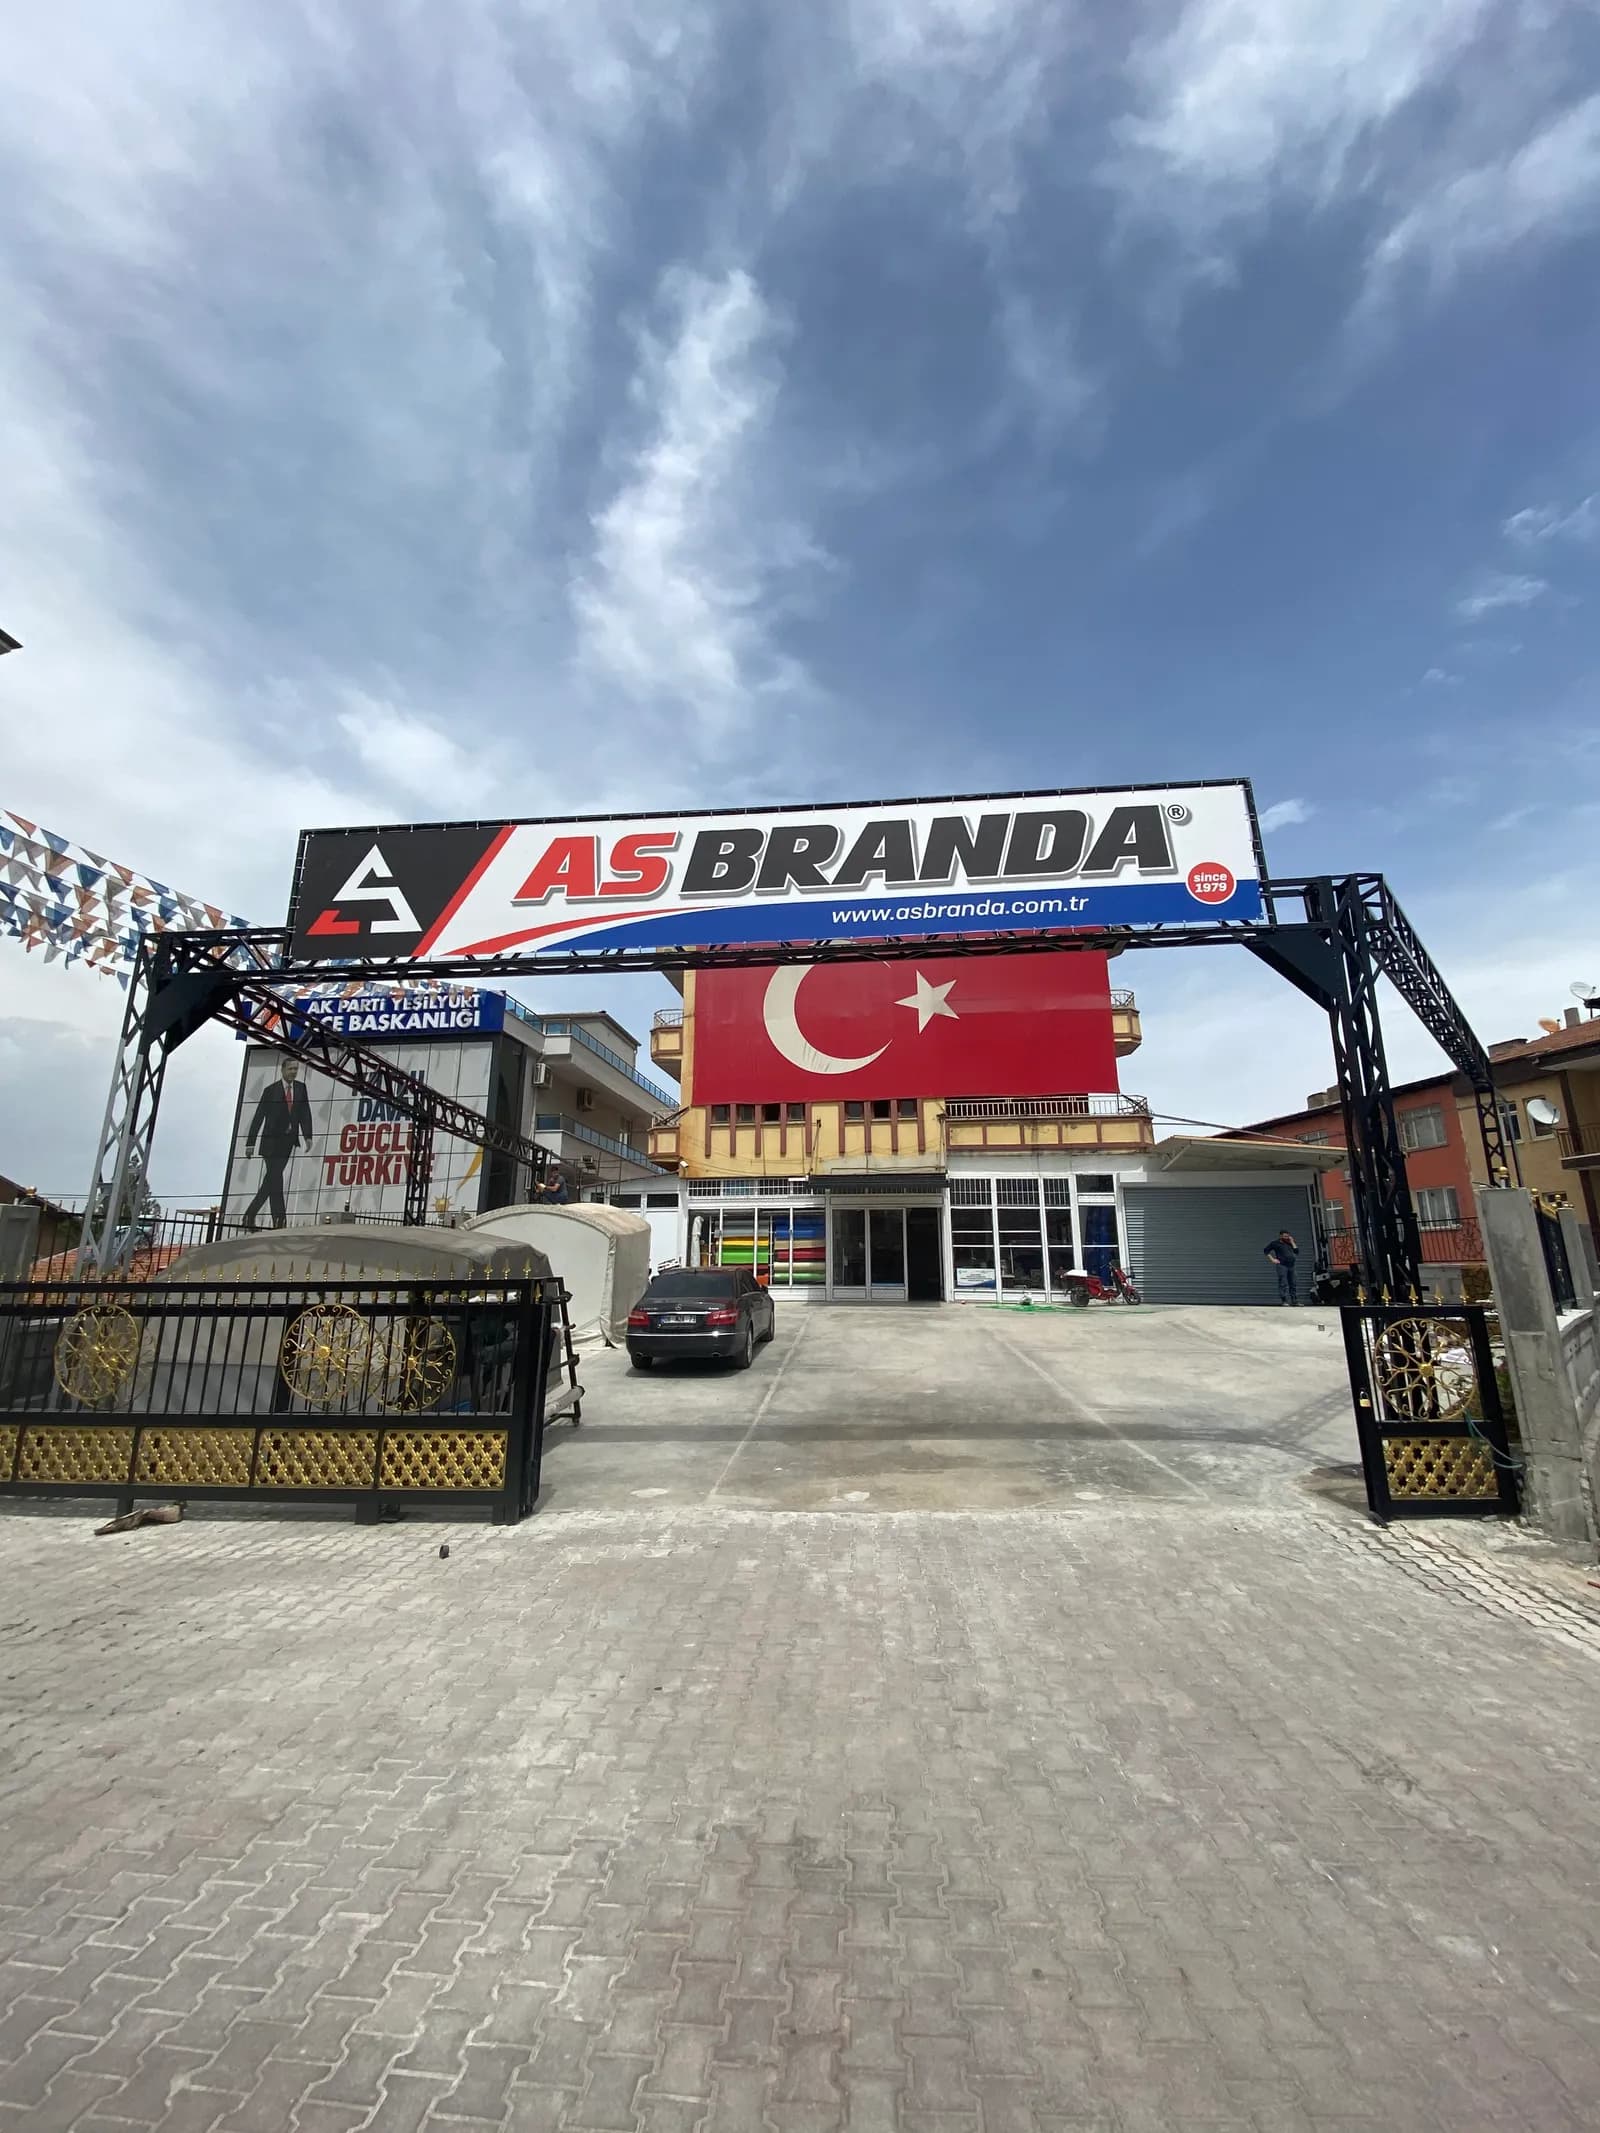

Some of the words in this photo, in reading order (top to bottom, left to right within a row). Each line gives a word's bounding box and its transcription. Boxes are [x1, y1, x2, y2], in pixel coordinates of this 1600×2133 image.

[1193, 872, 1228, 883] since
[1194, 882, 1228, 893] 1979
[831, 896, 1090, 925] www.asbranda.com.tr
[307, 1000, 334, 1014] AK
[349, 1009, 480, 1031] BAŞKANLIĞI
